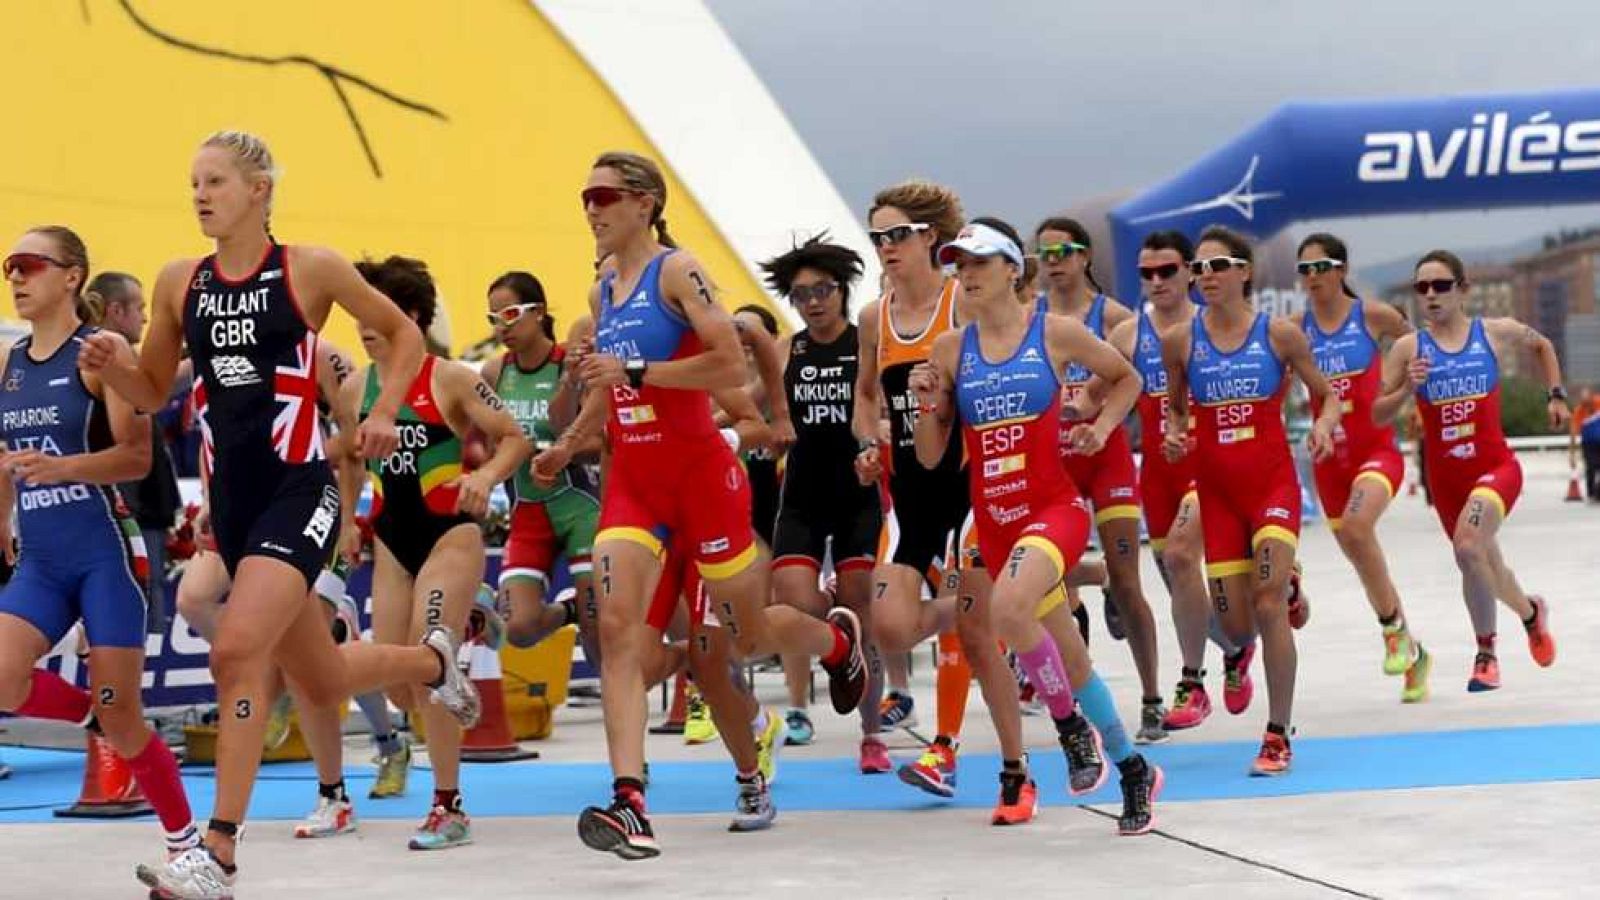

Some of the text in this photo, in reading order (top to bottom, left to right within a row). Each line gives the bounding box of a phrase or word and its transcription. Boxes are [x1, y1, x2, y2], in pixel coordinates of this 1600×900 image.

[1357, 112, 1600, 182] avilés
[195, 287, 270, 318] PALLANT
[210, 317, 257, 348] GBR
[794, 382, 852, 402] KIKUCHI
[1205, 378, 1260, 401] ALVAREZ
[2, 404, 60, 431] PRIARONE
[802, 404, 848, 425] JPN
[974, 391, 1028, 422] PEREZ
[1216, 403, 1253, 427] ESP
[1441, 400, 1476, 424] ESP
[13, 435, 63, 457] ITA
[982, 424, 1025, 455] ESP
[20, 484, 91, 511] arena
[876, 582, 889, 600] 7
[961, 595, 974, 613] 7
[101, 687, 115, 706] 2
[234, 699, 251, 719] 3
